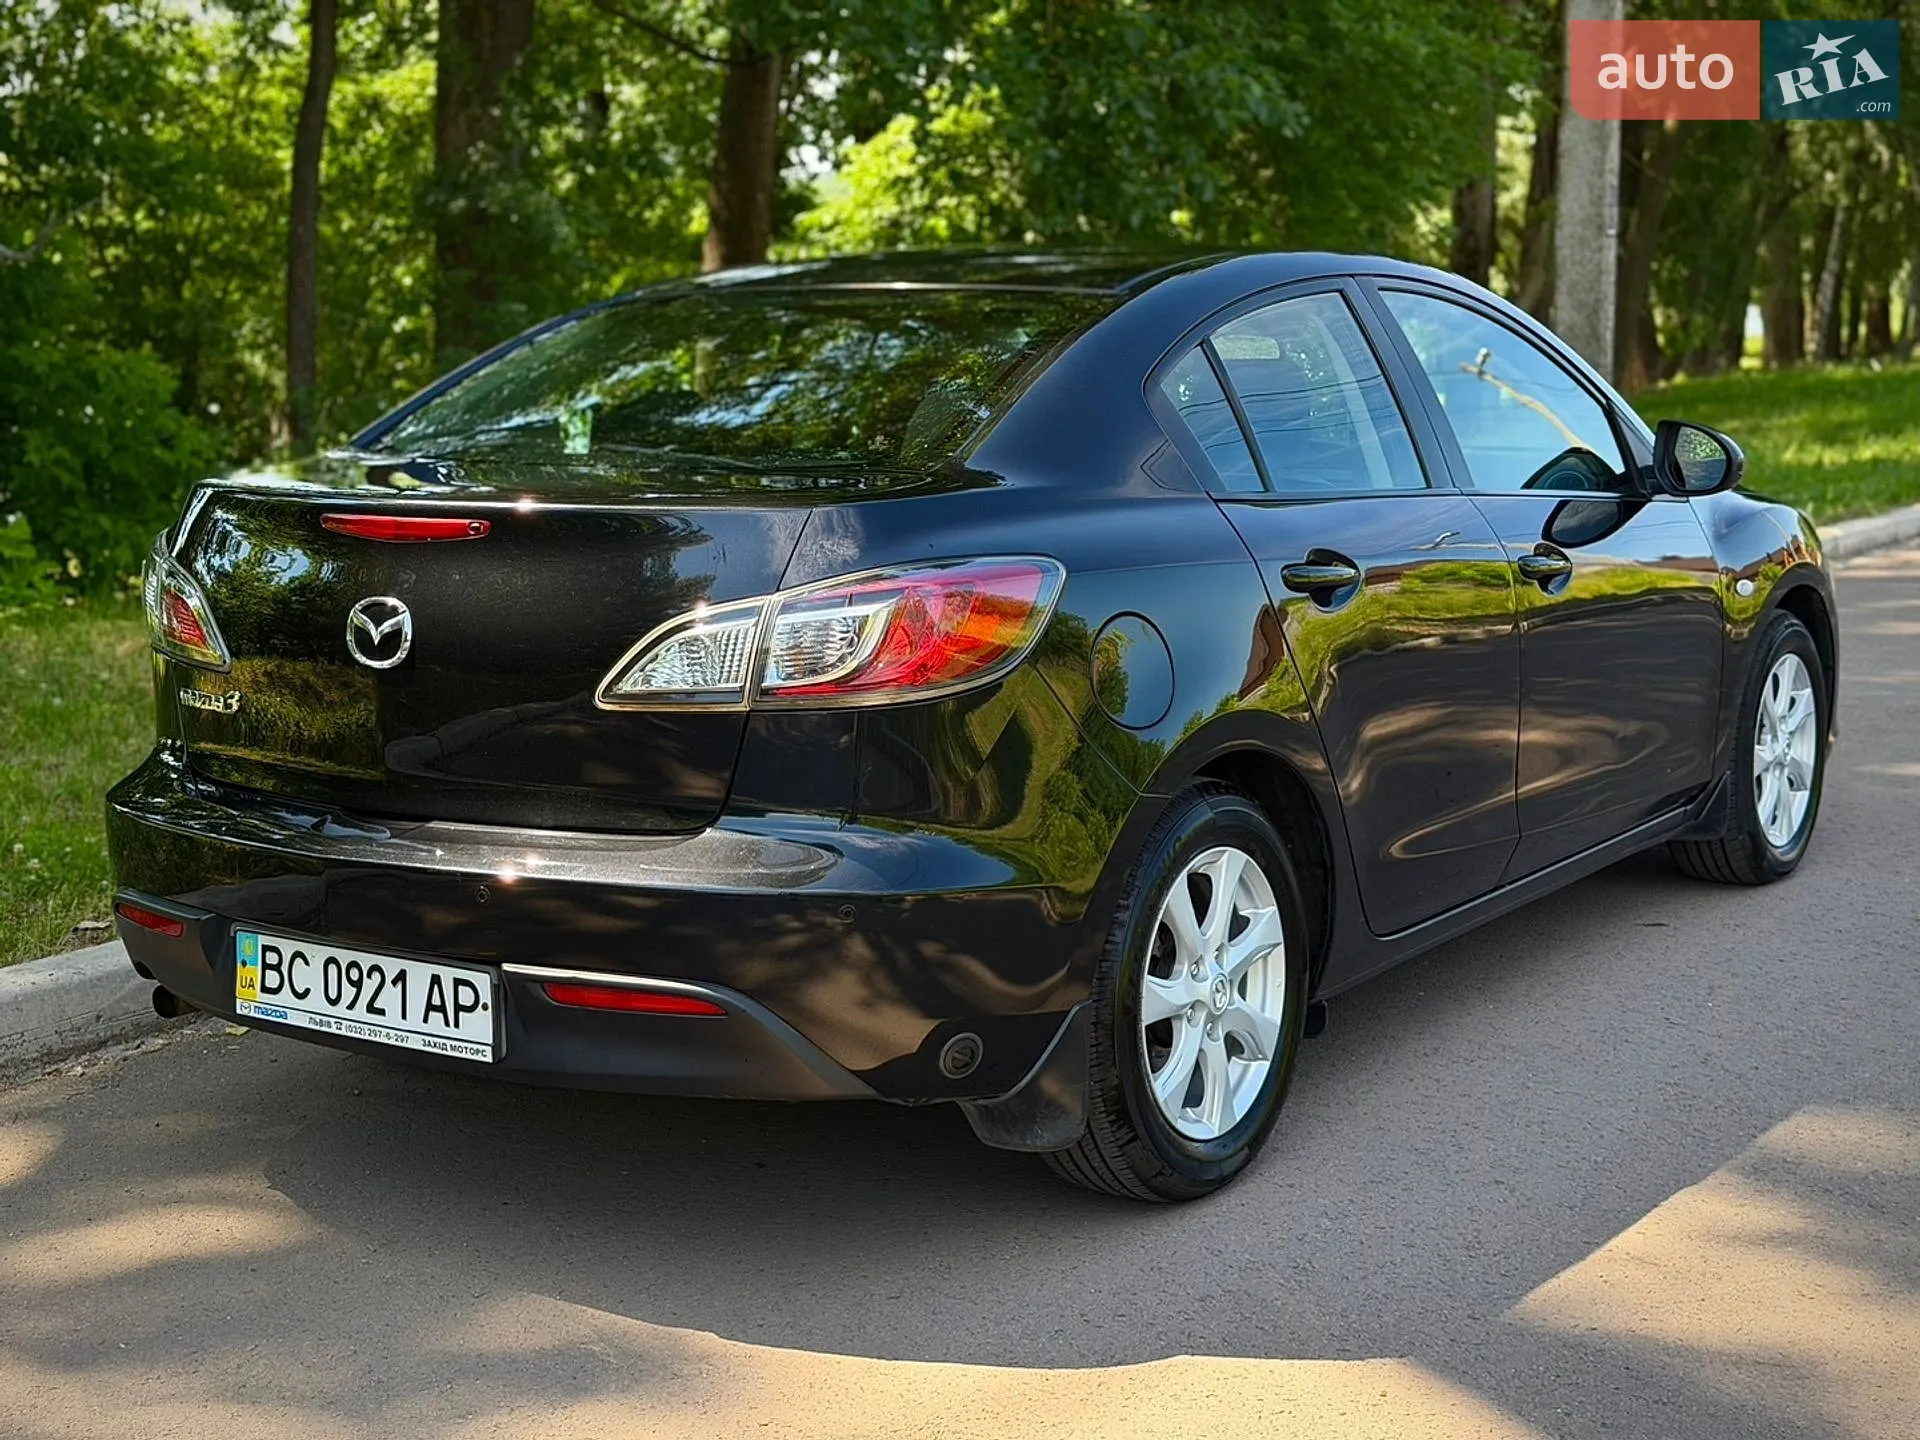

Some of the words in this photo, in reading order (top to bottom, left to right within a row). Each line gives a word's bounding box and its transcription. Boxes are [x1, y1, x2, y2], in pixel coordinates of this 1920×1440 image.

[240, 975, 256, 991] UA
[260, 943, 311, 1000] BC
[323, 956, 408, 1021] 0921
[422, 973, 480, 1029] AP
[253, 1005, 288, 1020] mazda
[449, 1043, 487, 1058] МОТОРС
